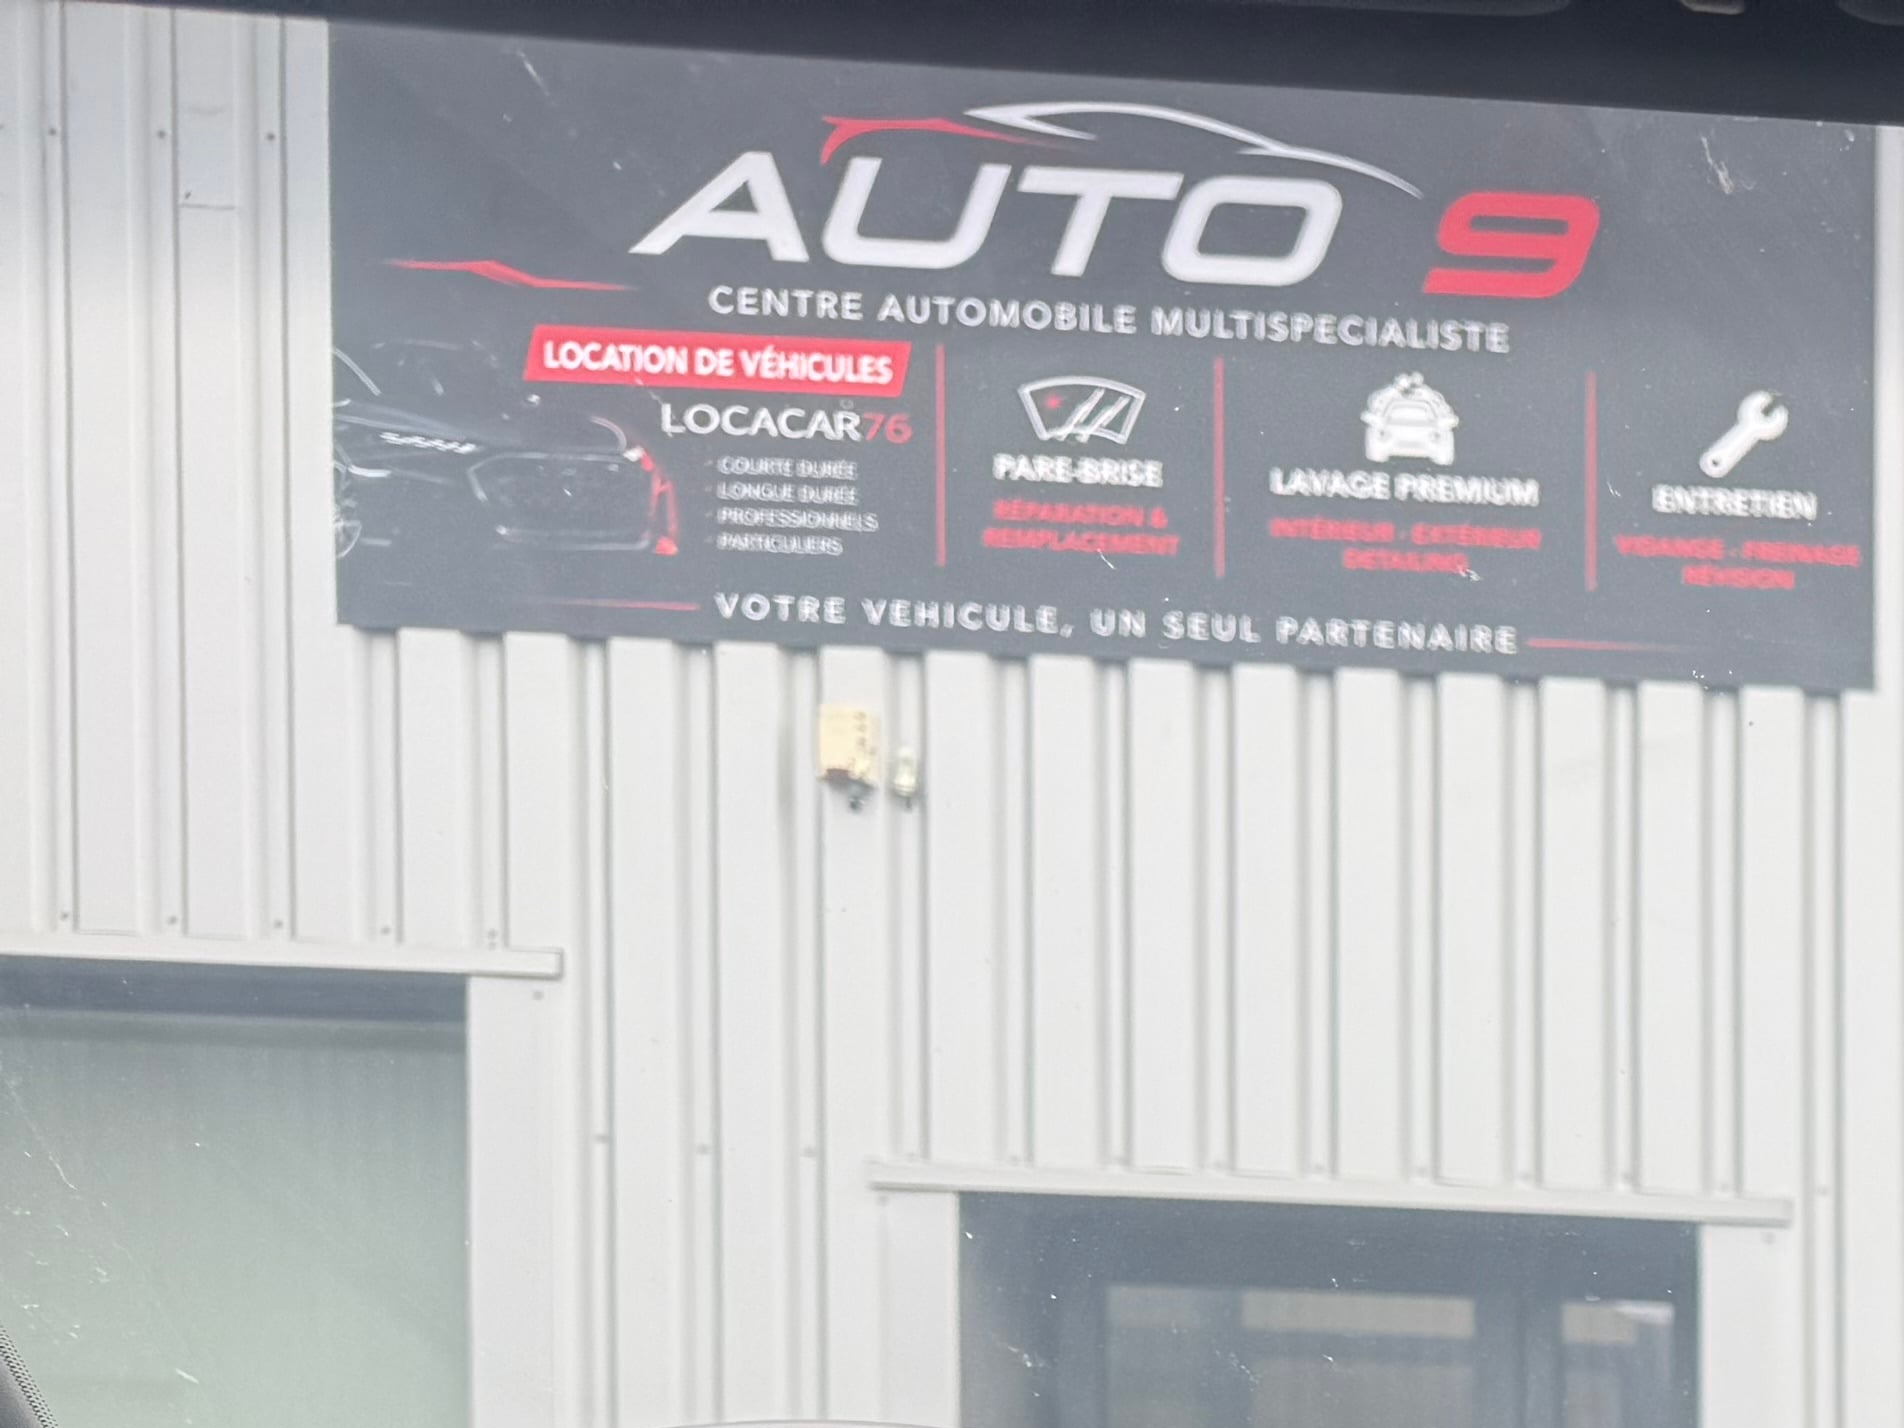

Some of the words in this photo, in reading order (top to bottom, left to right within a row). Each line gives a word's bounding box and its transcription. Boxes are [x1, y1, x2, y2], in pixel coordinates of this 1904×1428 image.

[628, 150, 1342, 287] AUTO
[1422, 191, 1600, 299] 9
[708, 285, 864, 321] CENTRE
[877, 295, 1136, 335] AUTOMOBILE
[1151, 306, 1510, 353] MULTISPECIALISTE
[544, 340, 688, 375] LOCATION
[695, 348, 735, 376] DE
[738, 345, 893, 384] VÉHICULES
[717, 456, 794, 477] COURTE
[992, 453, 1163, 488] PARE-BRISE
[717, 481, 795, 503] LONGUE
[1269, 466, 1391, 500] LAVAGE
[1394, 472, 1540, 506] PREMIUM
[1652, 484, 1818, 520] ENTRETIEN
[717, 506, 879, 532] PROFESSIONNELS
[717, 532, 843, 556] PARTICULIERS
[714, 591, 846, 624] VOTRE
[861, 598, 1075, 638] VEHICULE,
[1089, 608, 1147, 638] UN
[1162, 610, 1261, 643] SEUL
[1275, 616, 1519, 655] PARTENAIRE
